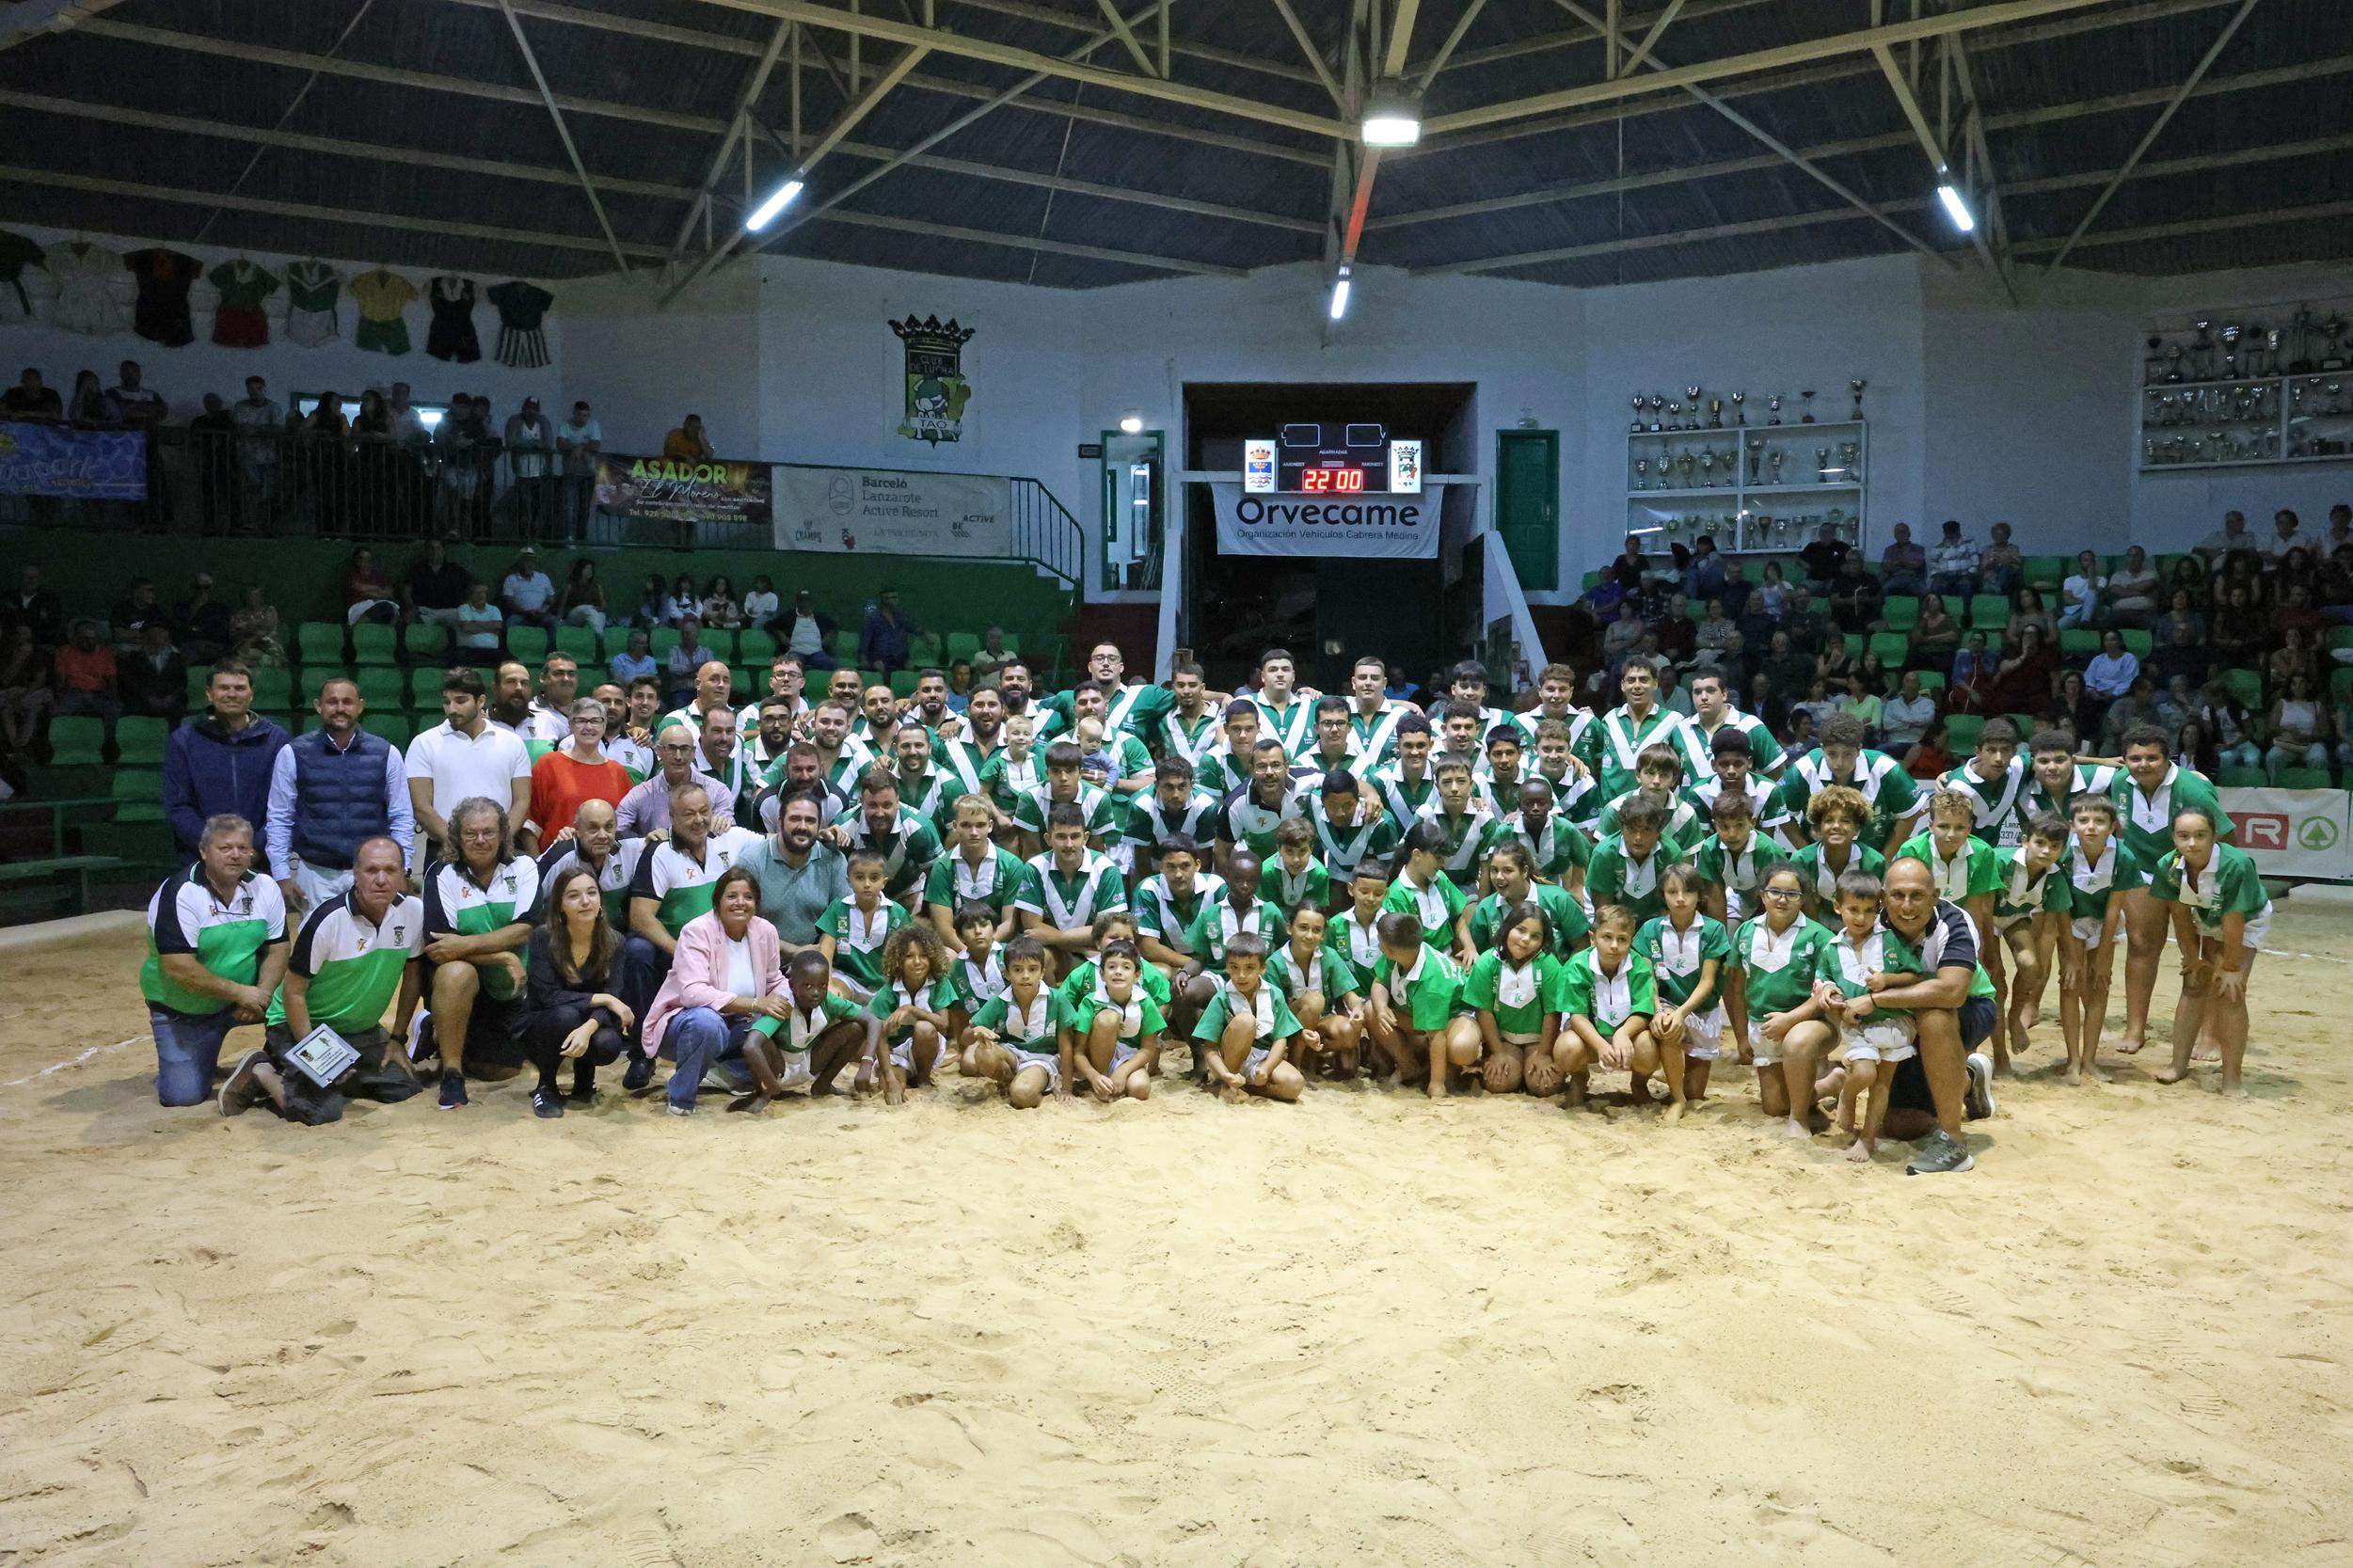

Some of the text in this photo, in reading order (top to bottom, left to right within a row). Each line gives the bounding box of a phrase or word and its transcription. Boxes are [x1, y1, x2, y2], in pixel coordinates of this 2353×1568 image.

[922, 420, 946, 429] TAO
[631, 458, 729, 484] ASADOR
[669, 472, 722, 501] Moreno
[862, 477, 908, 489] Barceló
[862, 490, 922, 504] Lanzarote
[863, 505, 939, 518] Active Resort
[1236, 498, 1420, 526] Orvecame
[962, 515, 994, 524] ACTIVE
[952, 522, 962, 531] BE
[1237, 529, 1296, 540] Organización
[1346, 530, 1383, 540] Cabrera
